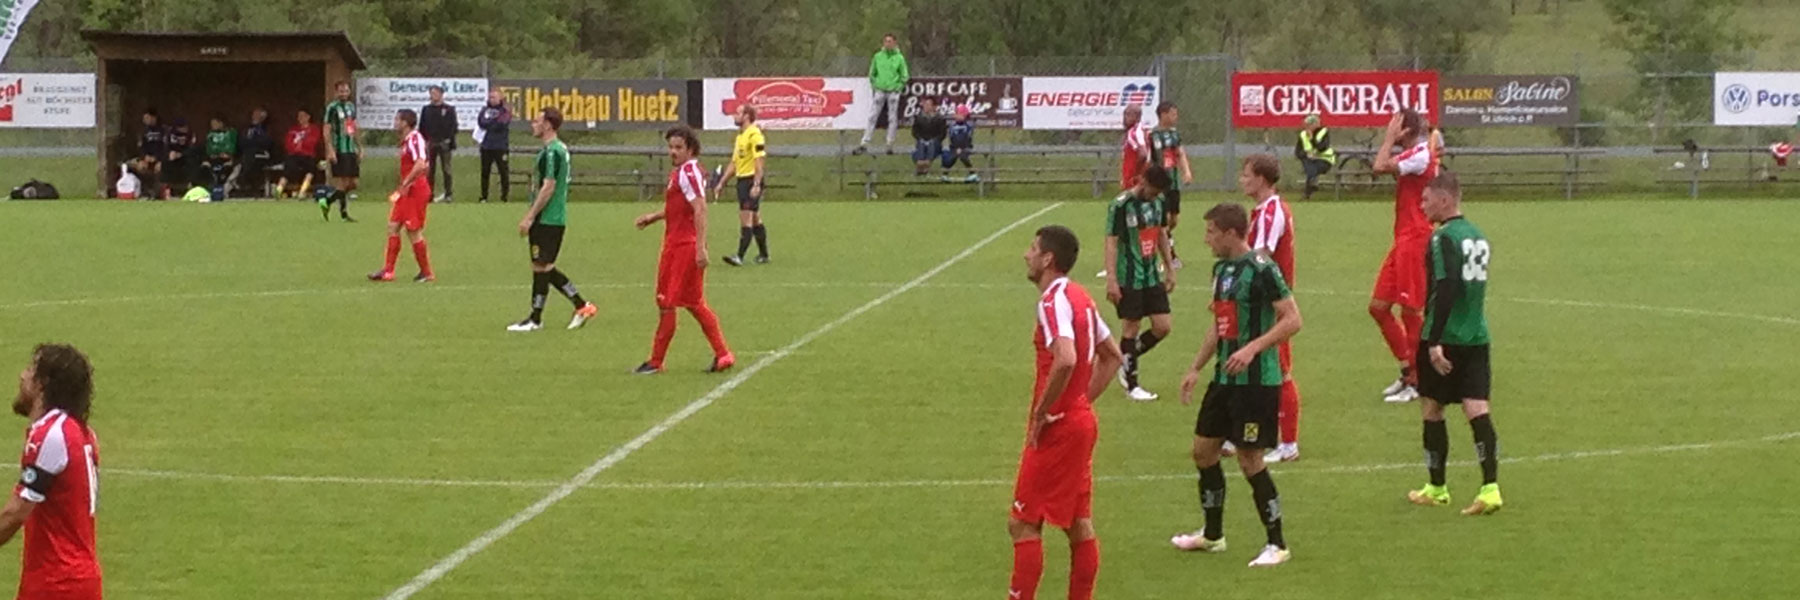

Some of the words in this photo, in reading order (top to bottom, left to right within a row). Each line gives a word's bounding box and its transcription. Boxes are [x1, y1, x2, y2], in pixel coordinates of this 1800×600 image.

[526, 88, 610, 121] Holzbau
[618, 88, 679, 121] Huetz
[1026, 93, 1119, 106] ENERGIE
[1267, 83, 1430, 115] GENERALI
[1444, 88, 1494, 100] SALON
[1497, 77, 1571, 105] Sabine
[1757, 90, 1800, 106] Pors
